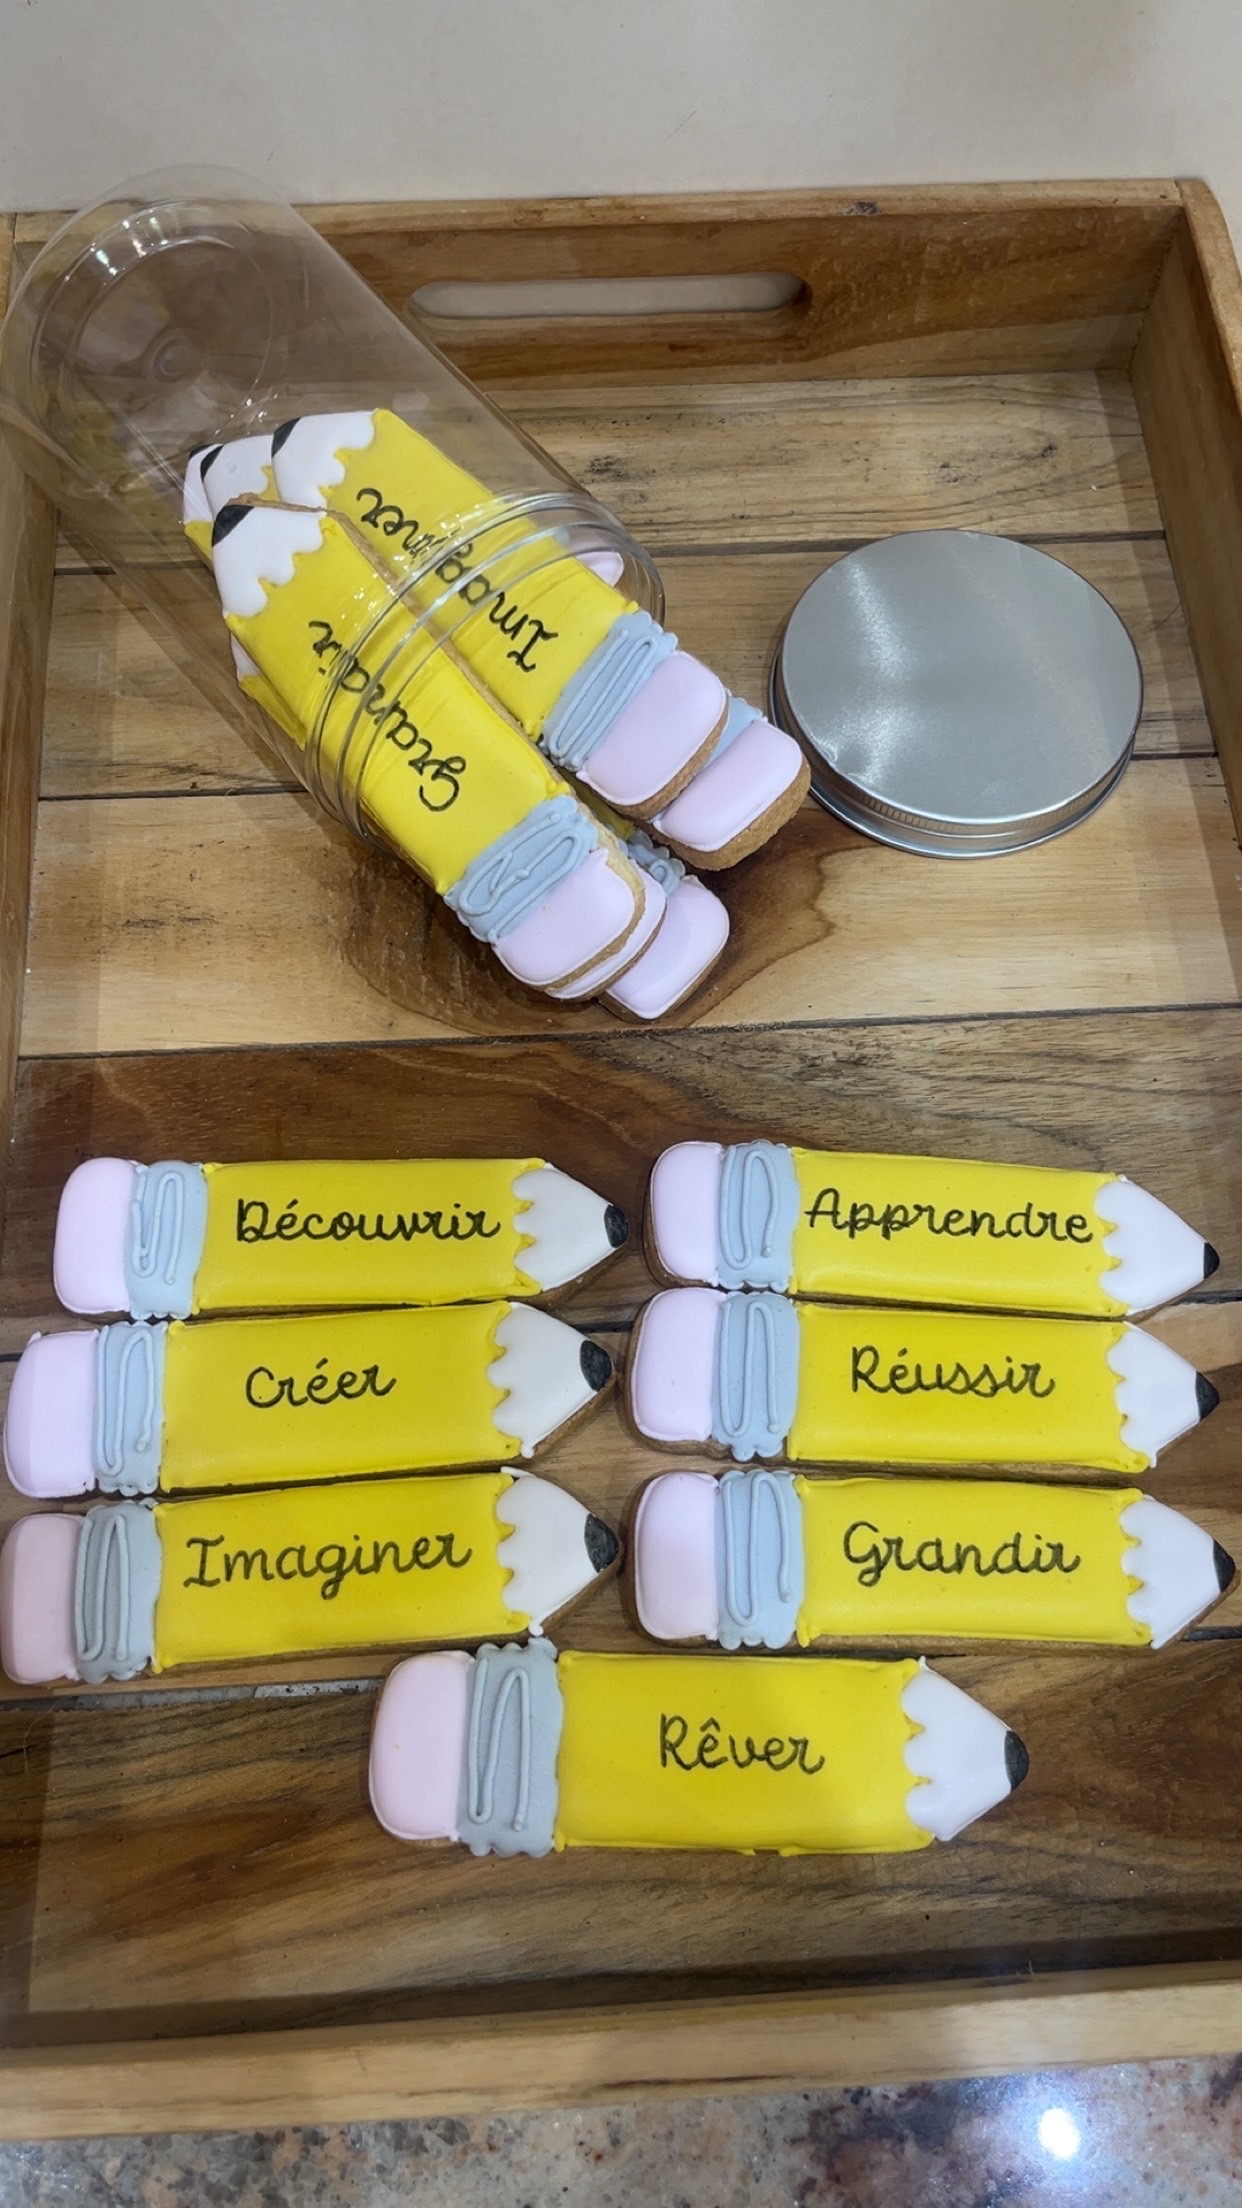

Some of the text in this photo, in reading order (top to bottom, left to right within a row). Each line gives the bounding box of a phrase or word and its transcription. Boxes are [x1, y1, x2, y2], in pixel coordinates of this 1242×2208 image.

[356, 488, 558, 672] Imagner
[236, 1198, 501, 1243] Découvrir
[804, 1188, 1095, 1244] Apprendre
[245, 1358, 397, 1408] Créer
[851, 1345, 1056, 1398] Réussir
[183, 1532, 472, 1600] Imaginer
[843, 1521, 1081, 1586] Grandir
[659, 1714, 825, 1774] Rêver
